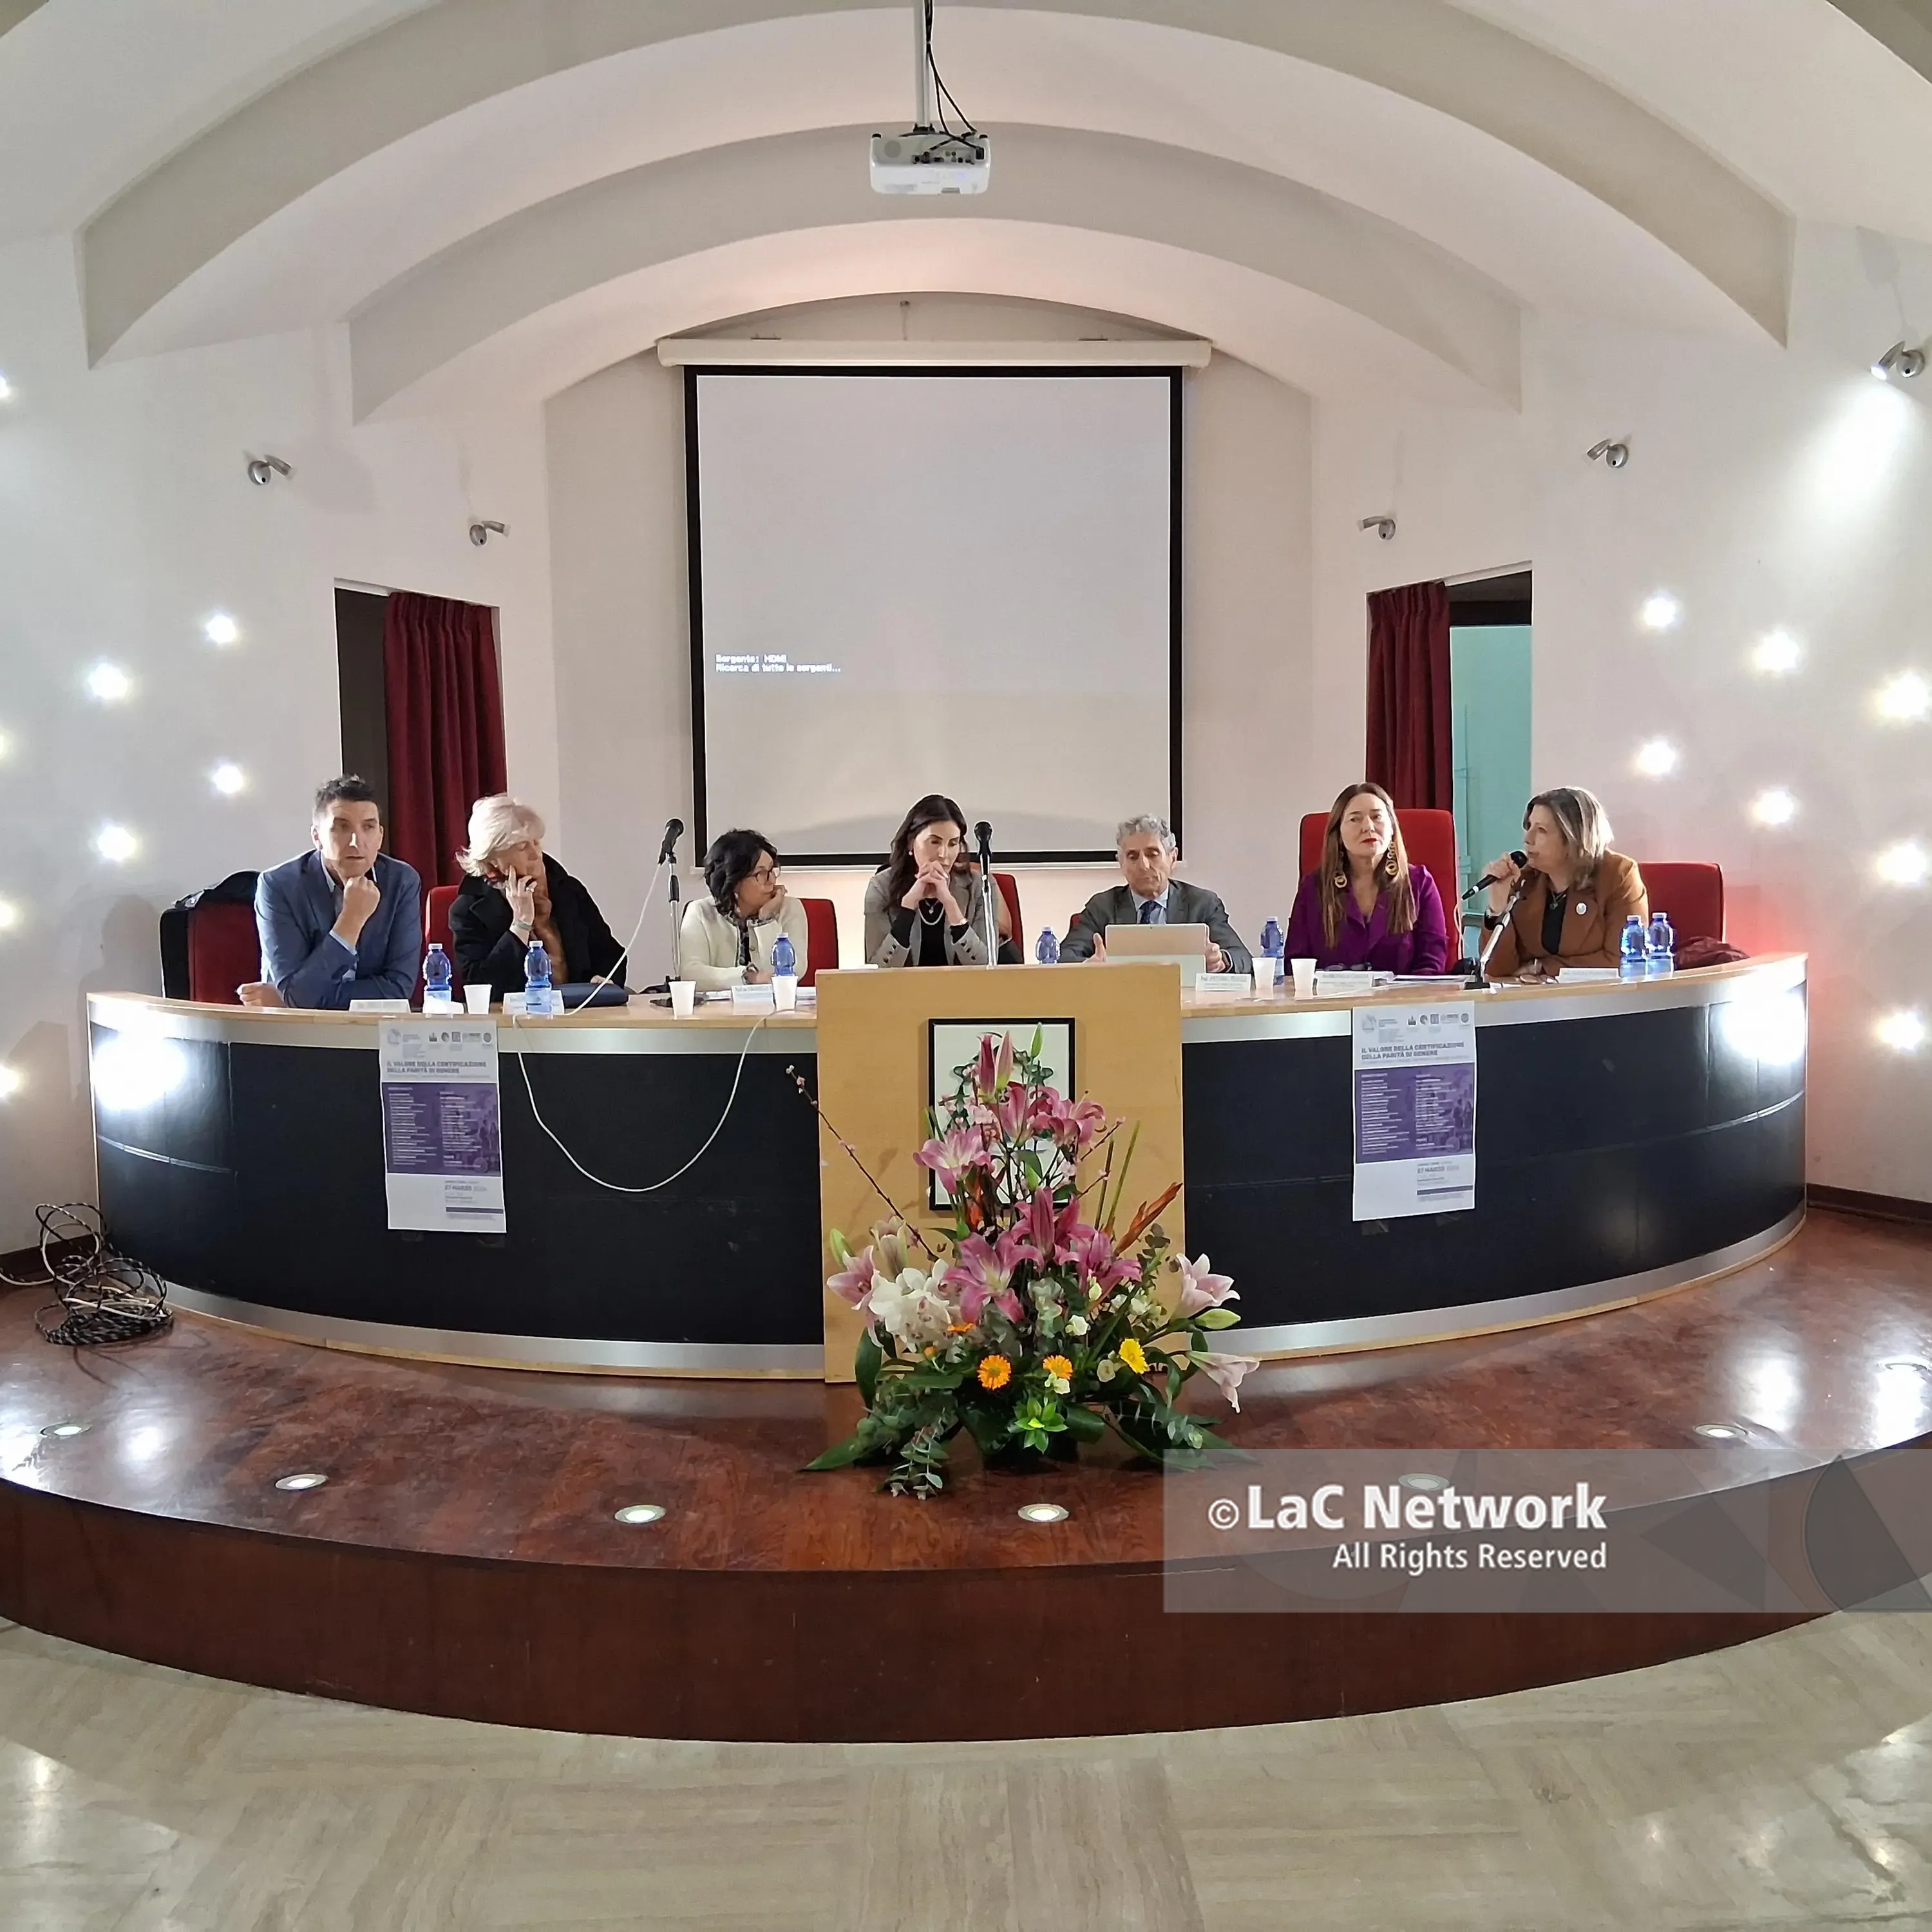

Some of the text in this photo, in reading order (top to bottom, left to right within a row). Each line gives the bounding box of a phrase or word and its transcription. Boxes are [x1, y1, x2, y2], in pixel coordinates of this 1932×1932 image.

[764, 654, 787, 663] HDMI
[715, 663, 750, 672] Ricerca
[751, 663, 760, 672] di
[762, 663, 784, 672] tutte
[786, 663, 795, 672] le
[1414, 1042, 1464, 1050] CERTIFICAZIONE
